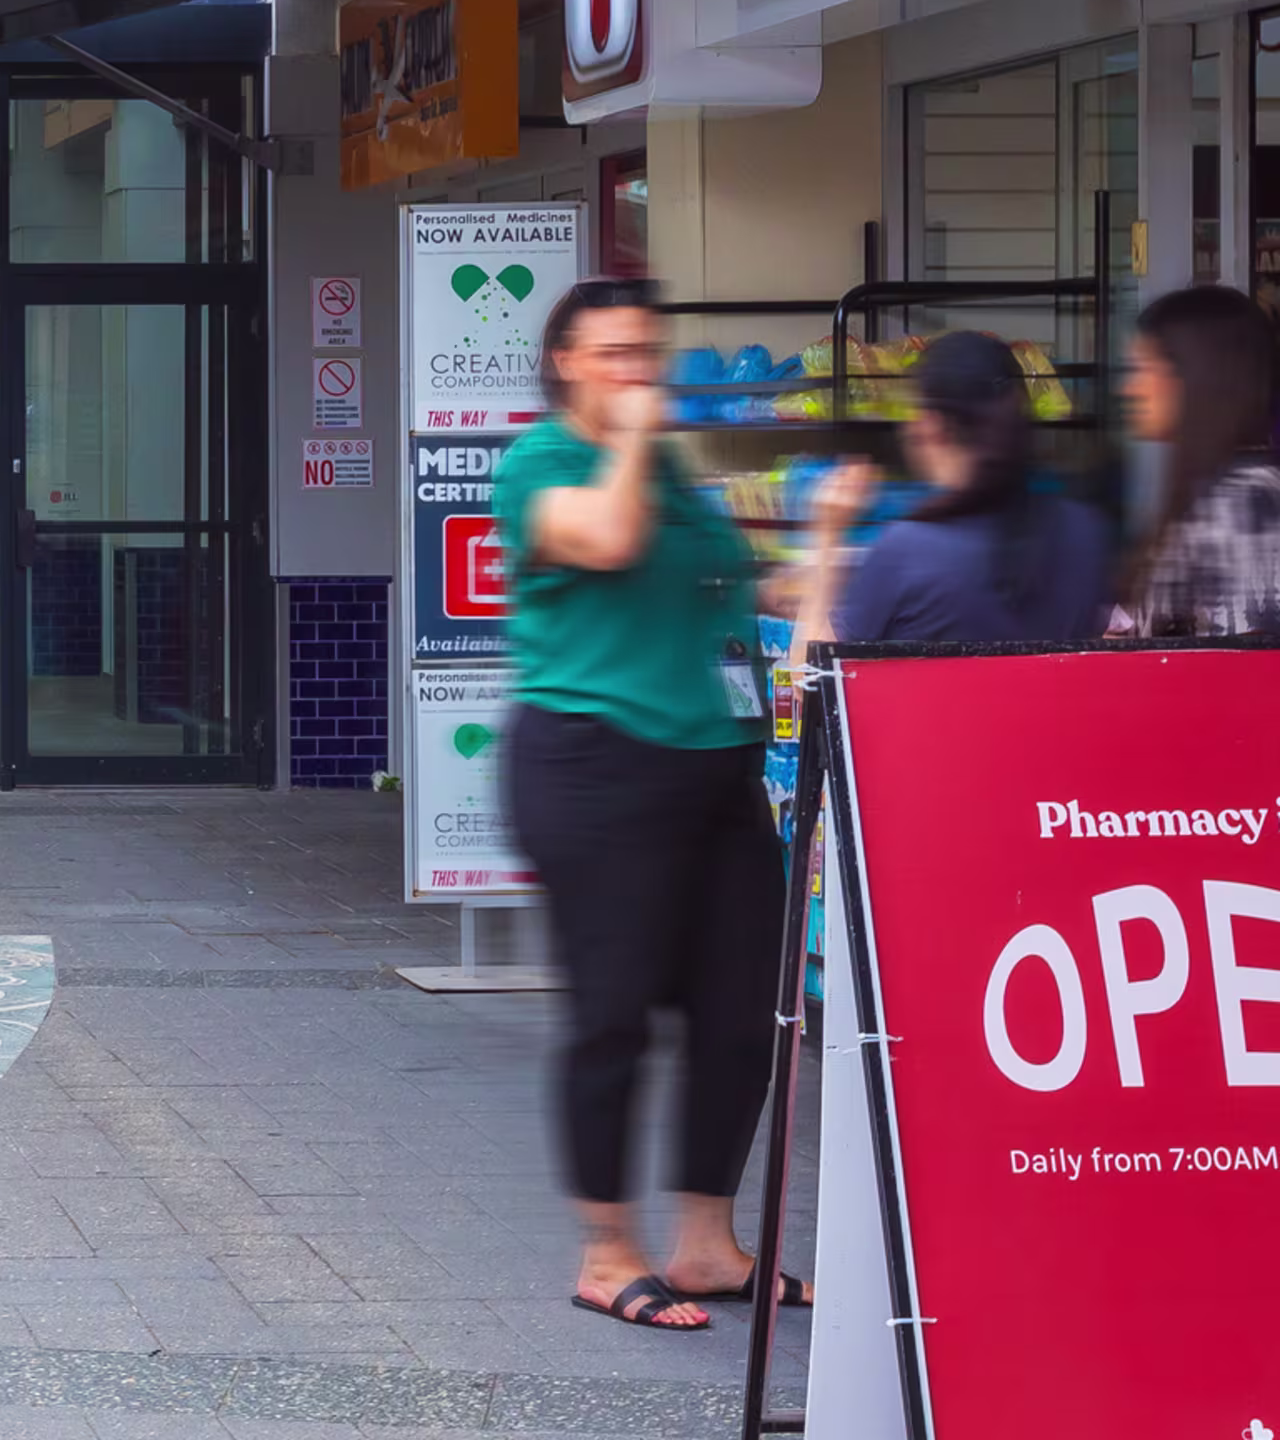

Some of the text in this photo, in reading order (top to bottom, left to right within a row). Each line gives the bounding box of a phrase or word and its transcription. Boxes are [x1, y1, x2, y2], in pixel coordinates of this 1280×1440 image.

[416, 212, 573, 225] Personalised Medicines
[416, 227, 573, 244] NOW AVAILABLE
[430, 354, 541, 374] CREATIV
[427, 410, 488, 427] THIS WAY
[418, 447, 502, 476] MEDI
[305, 460, 334, 486] NO
[419, 687, 465, 702] NOW
[1036, 800, 1269, 845] Pharmacy
[431, 870, 493, 887] THIS WAY
[1010, 1145, 1279, 1181] Daily from 7:00AM
